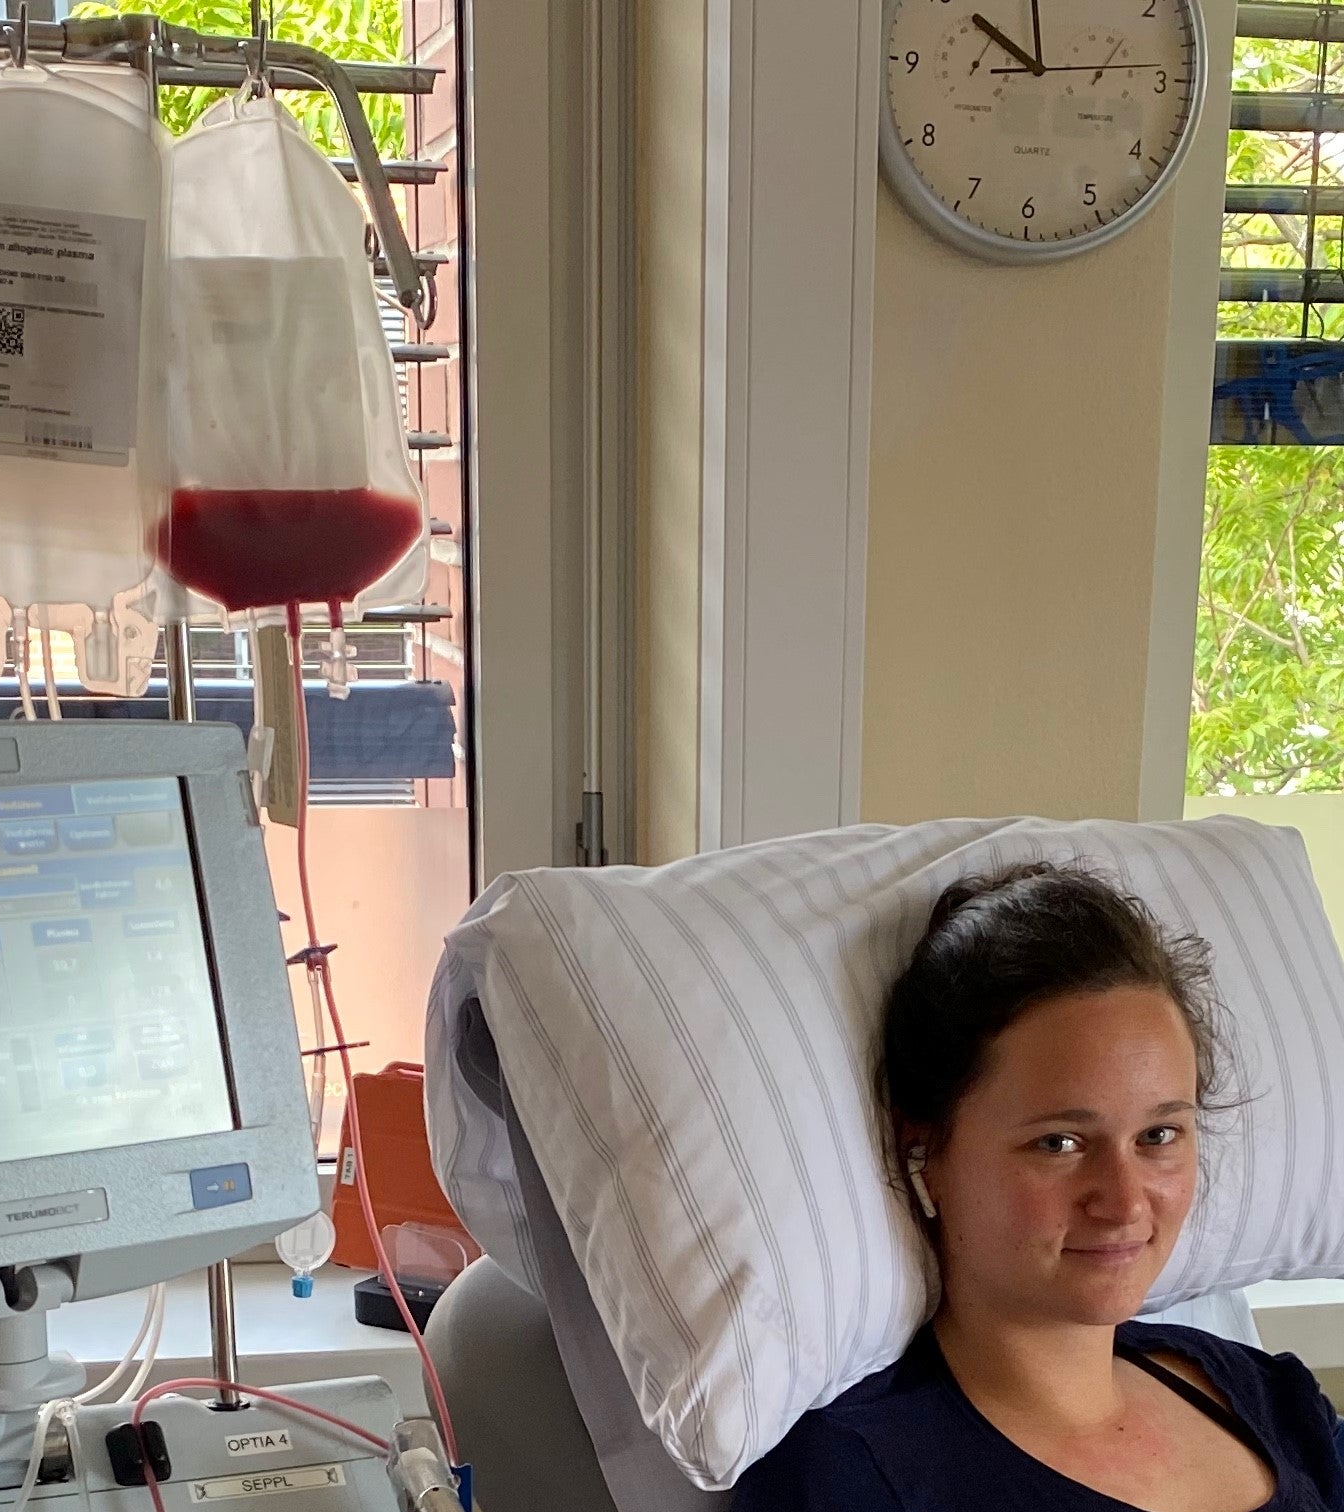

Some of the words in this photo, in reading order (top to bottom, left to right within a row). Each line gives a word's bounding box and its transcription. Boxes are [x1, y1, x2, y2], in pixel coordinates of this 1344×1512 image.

[1142, 0, 1156, 17] 2
[905, 51, 920, 74] 9
[1153, 71, 1167, 94] 3
[921, 123, 935, 146] 8
[1013, 145, 1050, 157] QUARTZ
[1128, 138, 1142, 160] 4
[968, 177, 982, 199] 7
[1083, 183, 1097, 206] 5
[1021, 196, 1035, 219] 6
[56, 248, 94, 260] plasma
[5, 1203, 80, 1223] TERUMOBCT
[227, 1435, 276, 1452] OPTIA
[278, 1433, 289, 1446] 4
[241, 1475, 294, 1492] SEPPL
